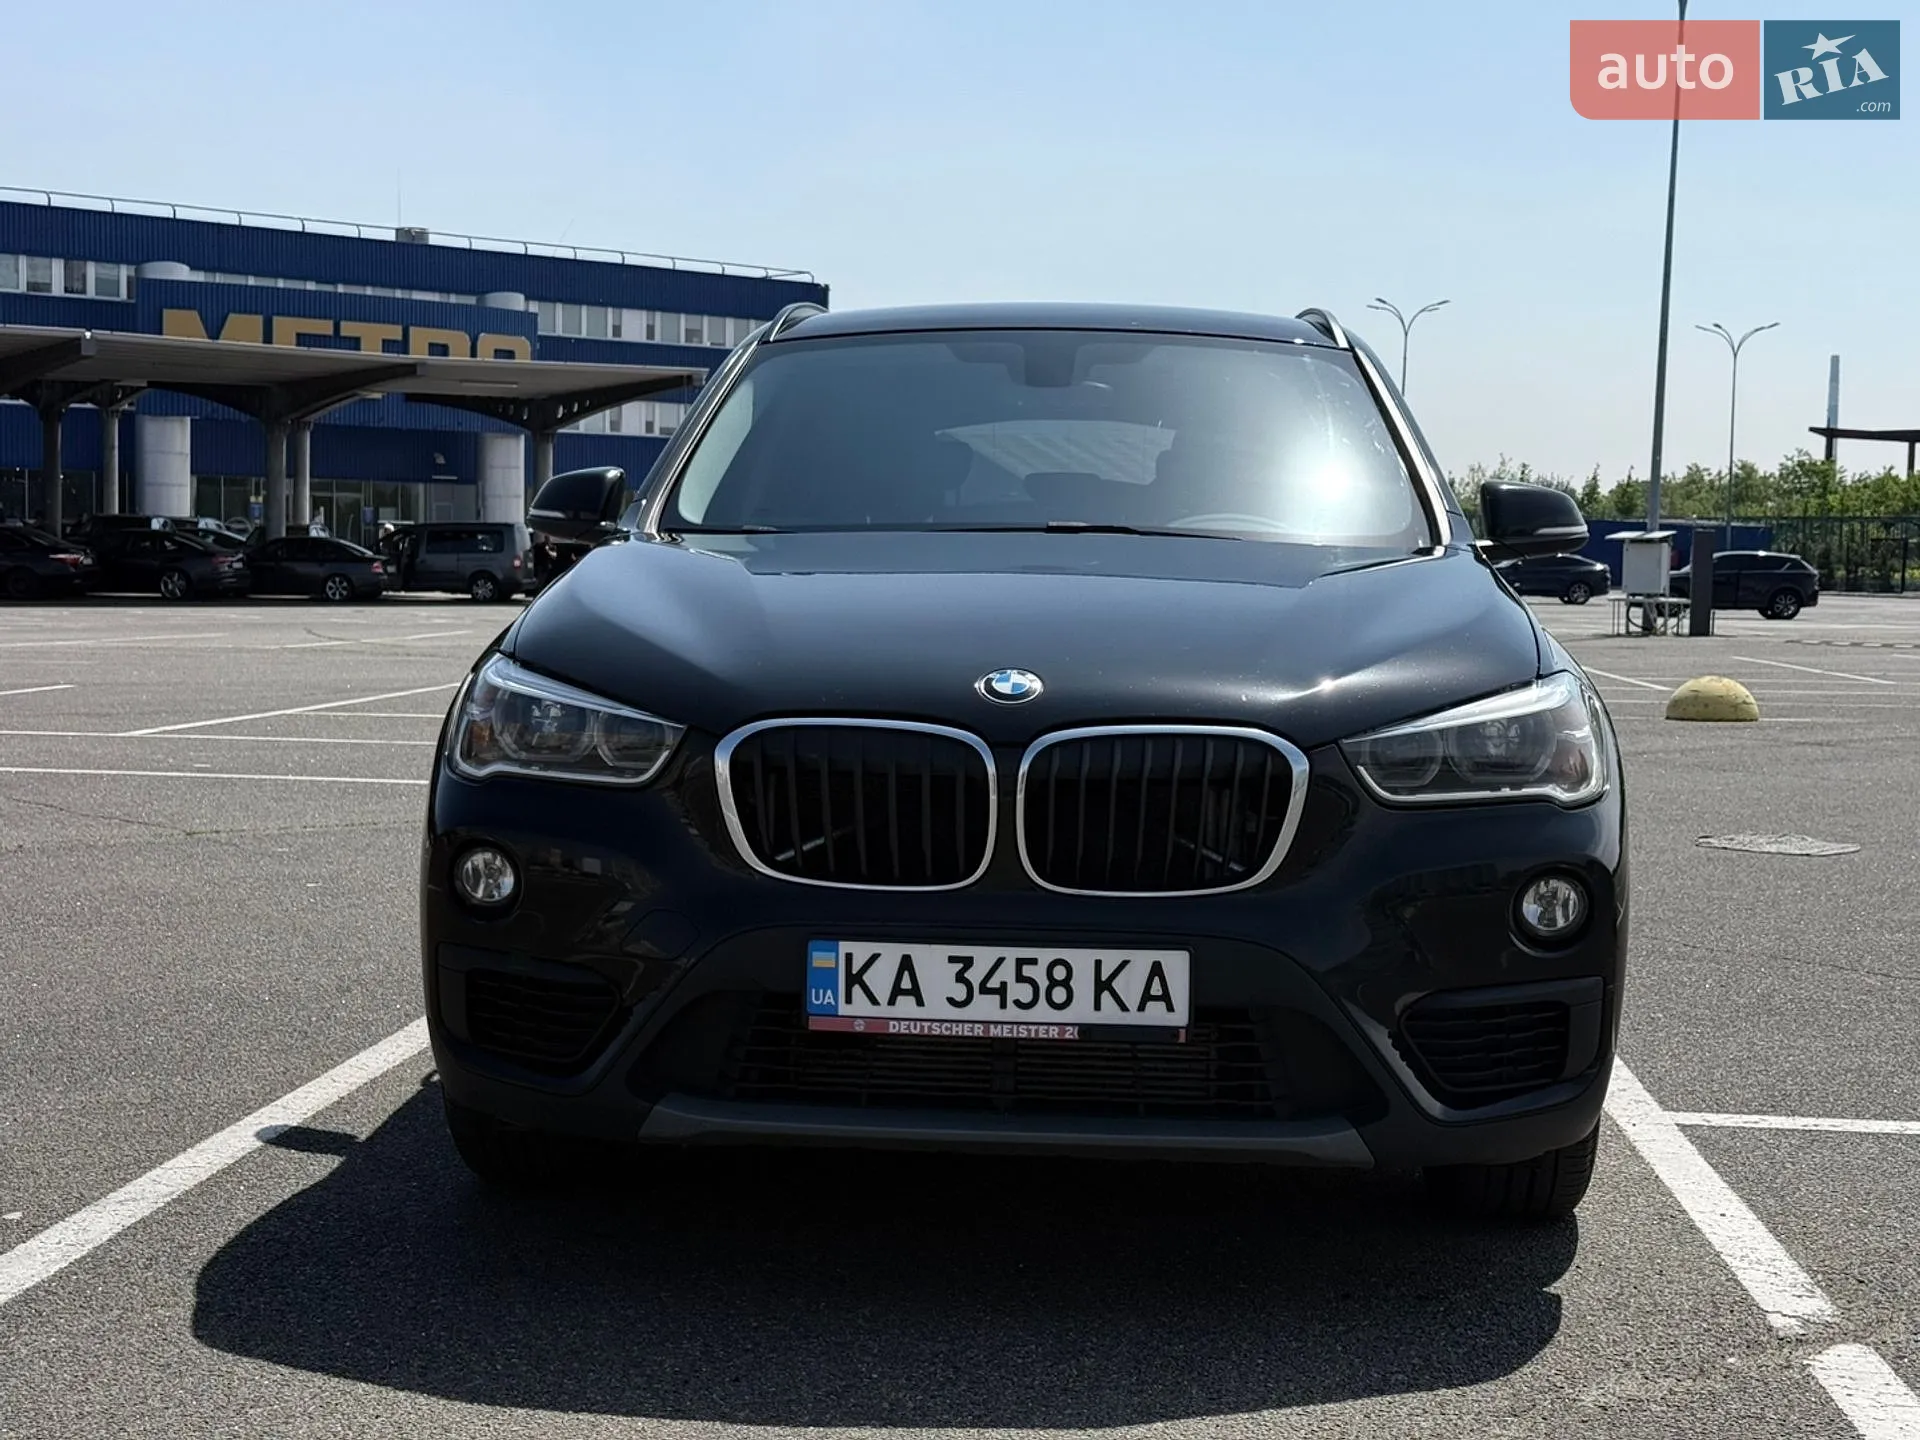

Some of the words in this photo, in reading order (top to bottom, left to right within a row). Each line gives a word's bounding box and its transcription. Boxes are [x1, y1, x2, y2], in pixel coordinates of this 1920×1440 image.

[844, 952, 925, 1007] KA
[945, 955, 1074, 1011] 3458
[1094, 958, 1175, 1013] KA
[811, 988, 836, 1006] UA
[888, 1020, 984, 1037] DEUTSCHER
[989, 1025, 1059, 1039] MEISTER
